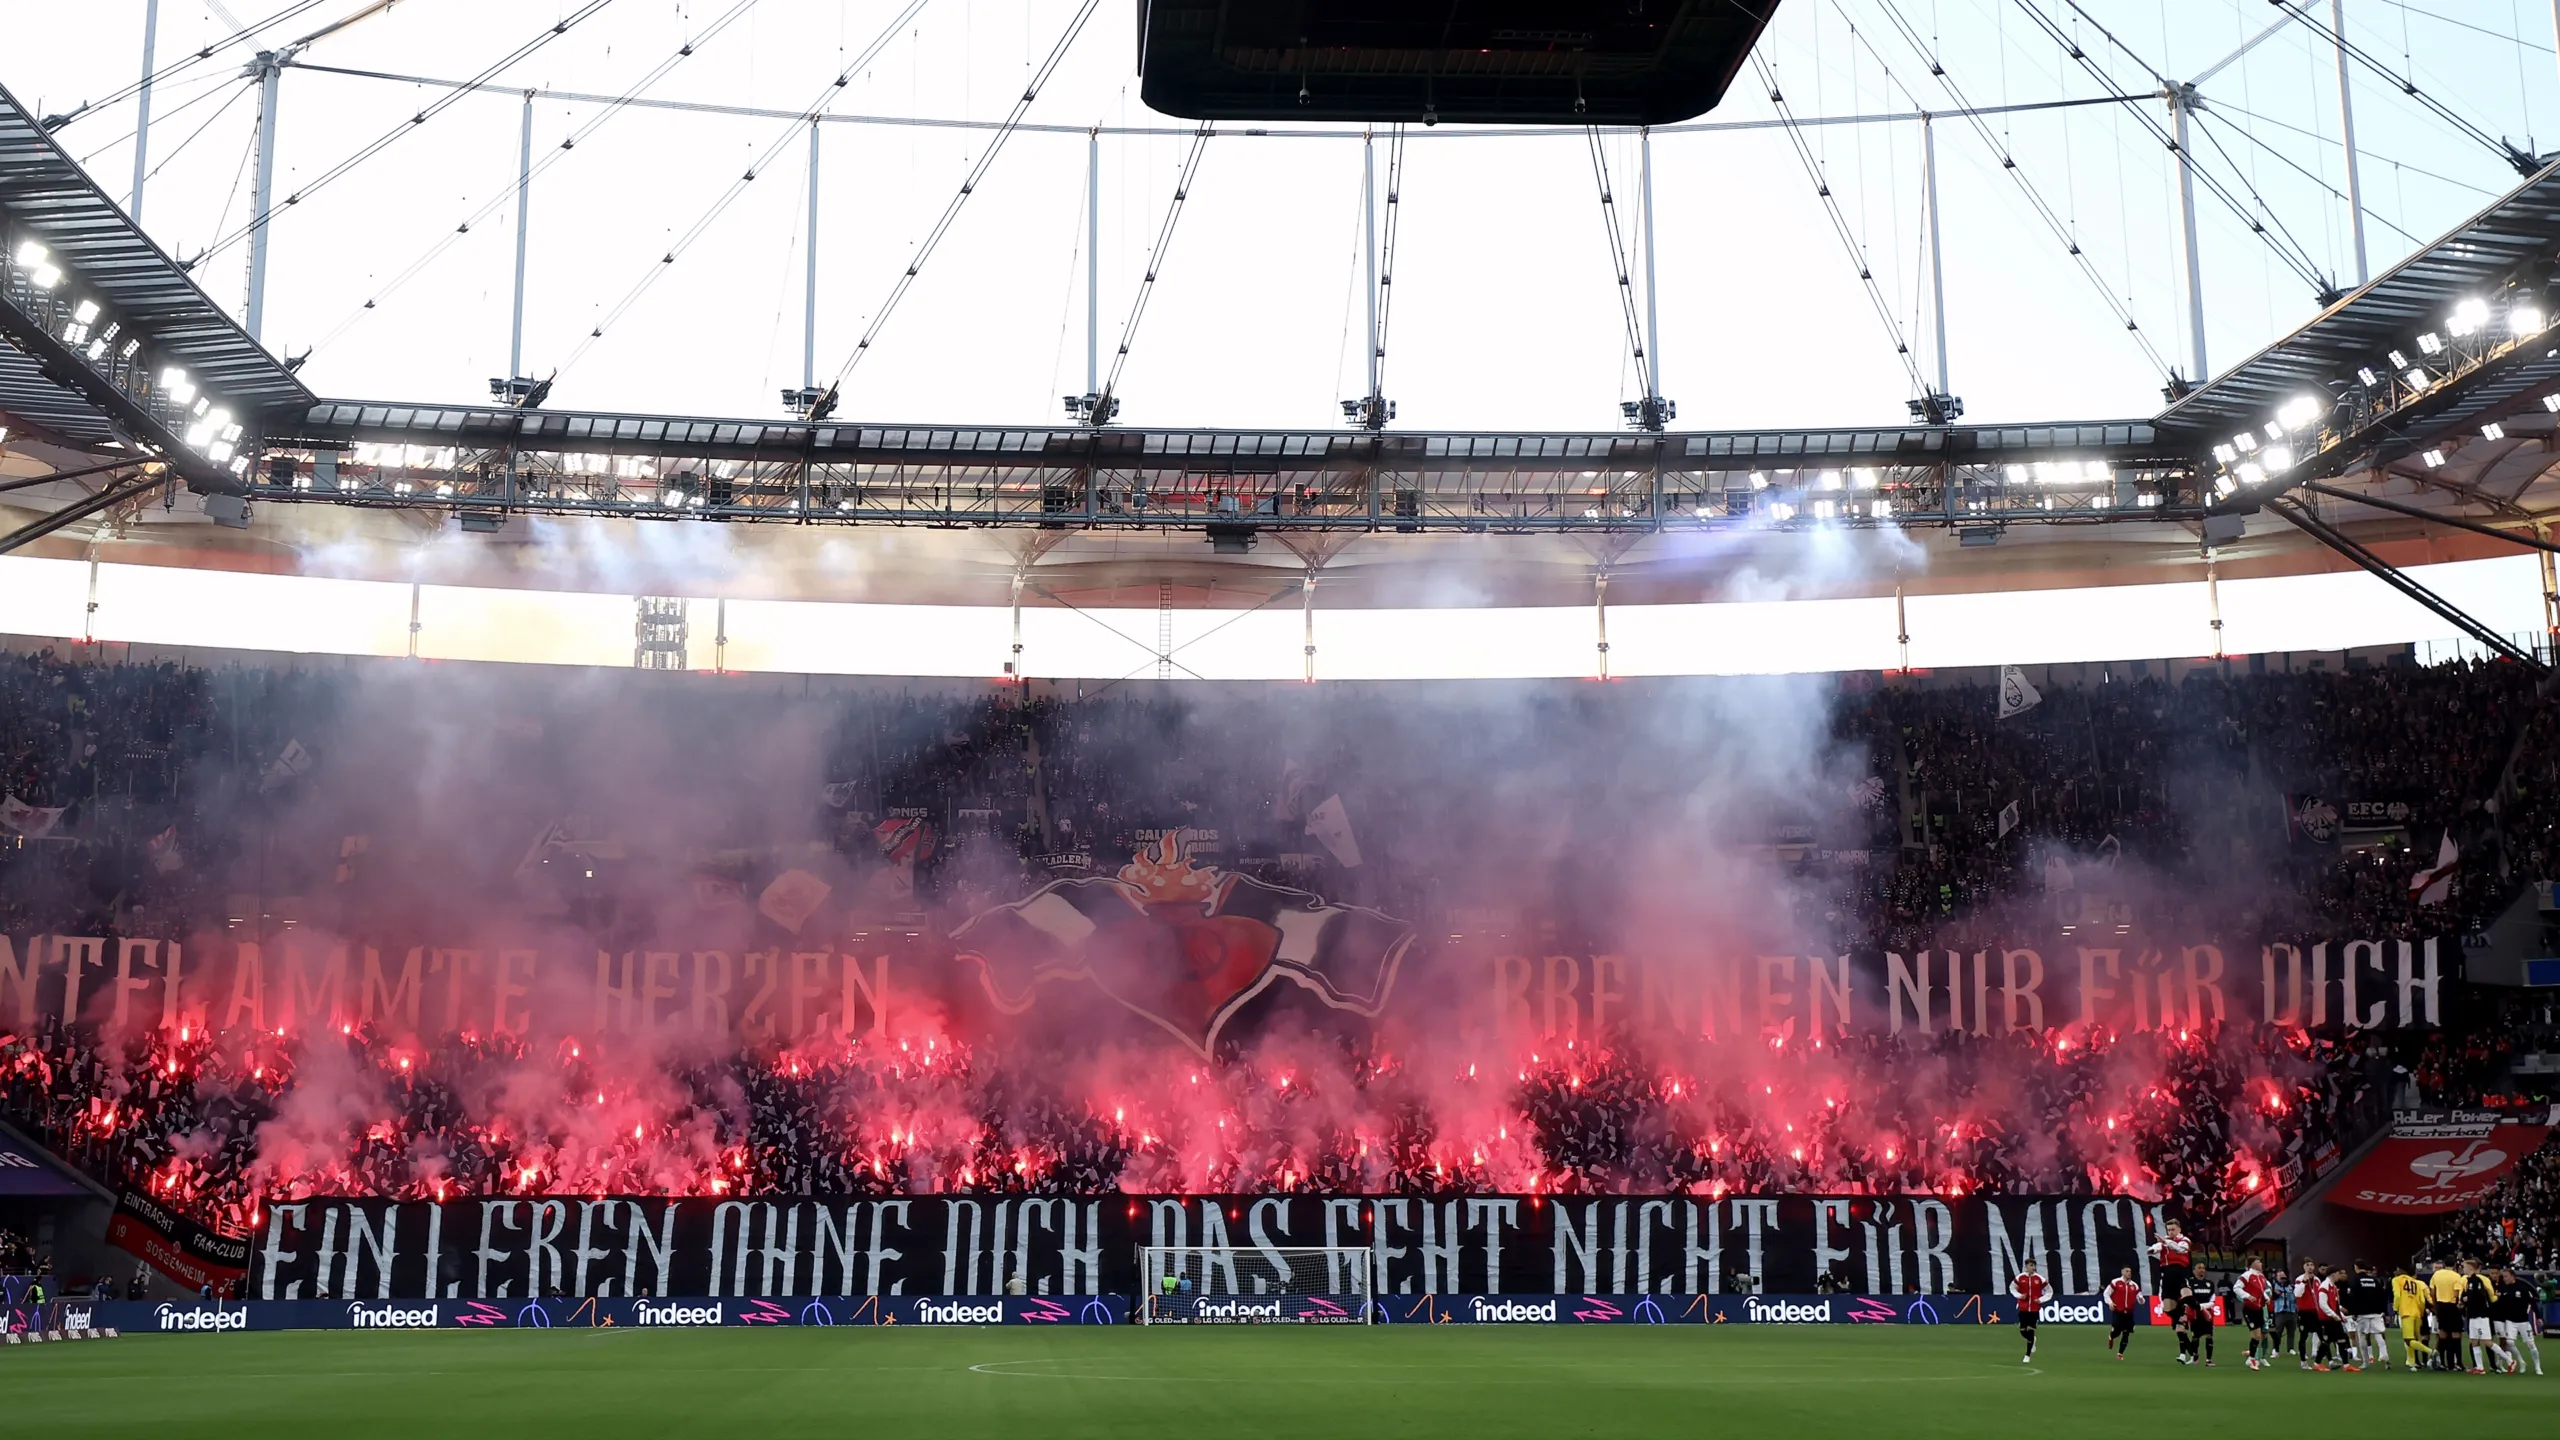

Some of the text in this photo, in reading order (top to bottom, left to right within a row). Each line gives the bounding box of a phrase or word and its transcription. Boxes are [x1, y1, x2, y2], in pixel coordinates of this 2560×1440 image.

[2347, 802, 2385, 815] EFC
[597, 947, 890, 1038] HERZEN
[1494, 936, 2442, 1042] BRENNEN NUR FÜR DICH
[116, 1224, 127, 1238] 19
[123, 1191, 246, 1260] EINTRACHT FAN-CLUB
[145, 1240, 206, 1284] SOSSENHEIM
[259, 1203, 400, 1299] EIN
[707, 1200, 912, 1297] OHNE
[940, 1200, 1104, 1297] DICH
[1148, 1200, 1292, 1297] DAS
[1325, 1200, 1518, 1296] GEHT
[1548, 1199, 1779, 1295] NICHT
[1811, 1199, 1954, 1295] FÜR
[1984, 1199, 2166, 1296] MICH
[2403, 1279, 2418, 1296] 40
[65, 1303, 92, 1331] indeed
[154, 1303, 247, 1330] indeed
[347, 1301, 438, 1327] indeed
[632, 1299, 722, 1325] indeed
[914, 1297, 1003, 1324] indeed
[1193, 1297, 1280, 1317] indeed
[1469, 1296, 1556, 1323] indeed
[1743, 1295, 1831, 1322] indeed
[2039, 1300, 2104, 1323] deed
